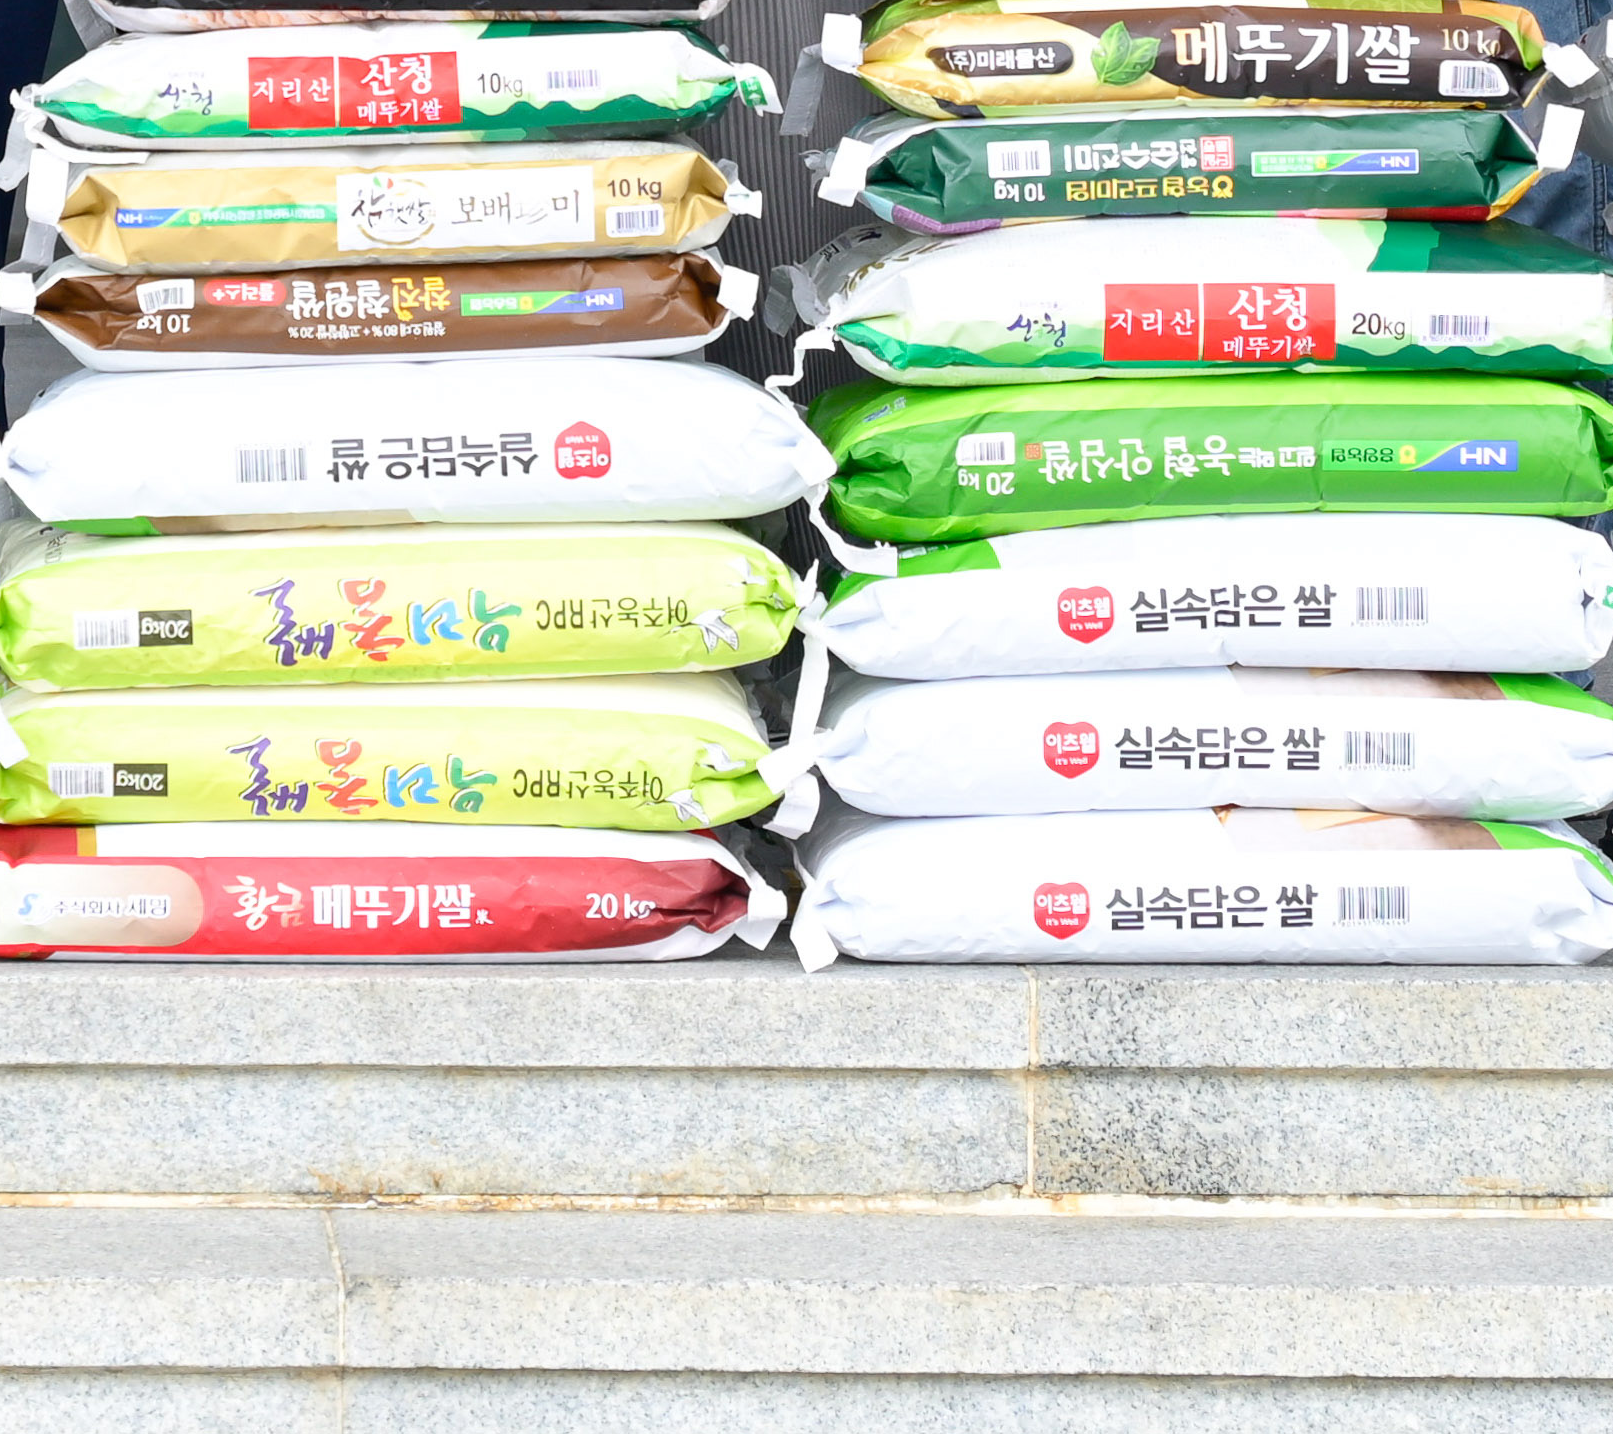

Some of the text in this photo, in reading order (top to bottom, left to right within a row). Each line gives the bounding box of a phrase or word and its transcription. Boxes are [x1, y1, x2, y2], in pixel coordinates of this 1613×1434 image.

[367, 54, 434, 95] 산청
[1174, 20, 1420, 85] 메뚜기쌀
[252, 76, 333, 104] 지리산
[1109, 307, 1195, 337] 지리산
[1228, 285, 1309, 332] 산청
[327, 432, 538, 482] 실속담은 쌀
[1039, 439, 1157, 484] 안심쌀
[1059, 596, 1112, 620] 이츠웰
[1129, 583, 1337, 633] 실속담은 쌀
[1115, 725, 1326, 772] 실속담은 쌀
[585, 893, 618, 919] 20
[1105, 885, 1266, 930] 실속담은
